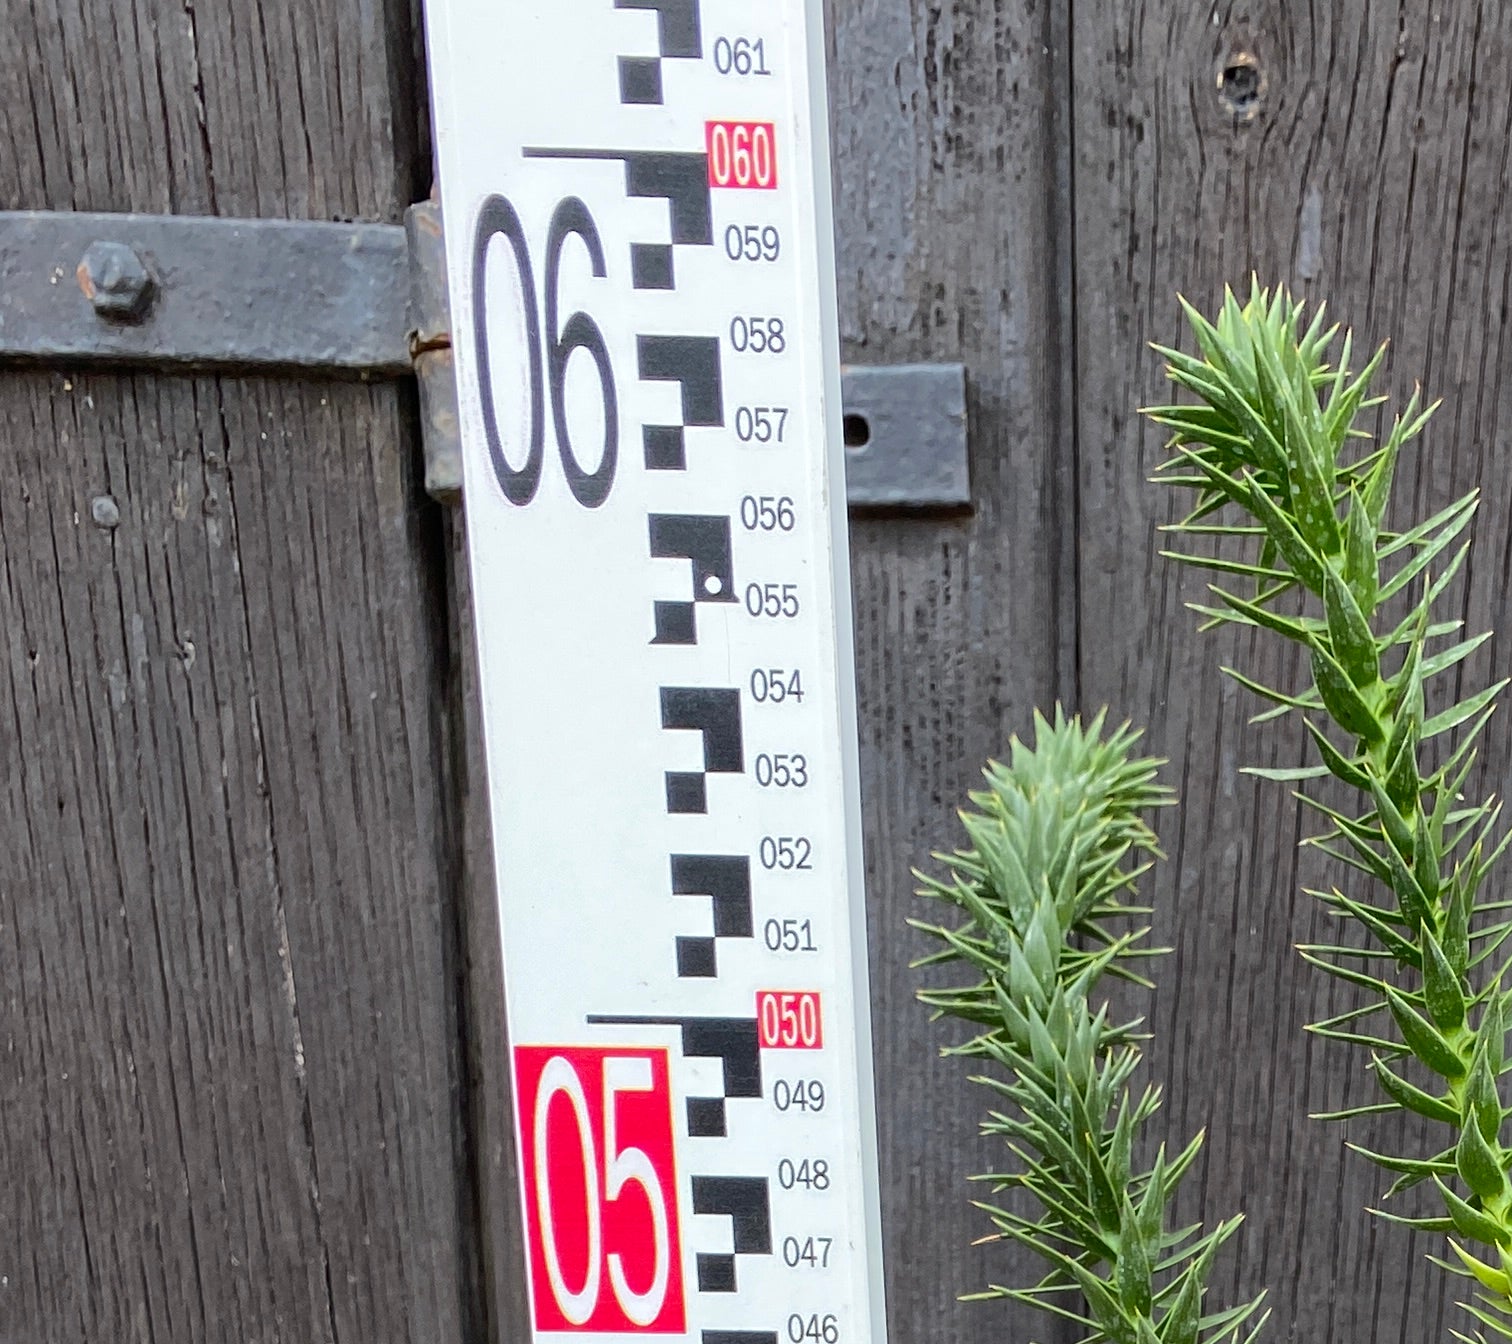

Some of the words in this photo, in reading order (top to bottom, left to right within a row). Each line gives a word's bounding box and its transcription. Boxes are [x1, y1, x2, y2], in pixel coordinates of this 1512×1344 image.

[714, 36, 771, 76] 061
[711, 123, 771, 187] 060
[724, 224, 780, 262] 059
[472, 193, 618, 508] 06
[730, 316, 786, 354] 058
[735, 406, 788, 443] 057
[740, 495, 795, 532] 056
[745, 582, 799, 618] 055
[750, 668, 805, 704] 054
[755, 753, 808, 788] 053
[759, 836, 813, 870] 052
[764, 918, 818, 952] 051
[762, 993, 817, 1047] 050
[773, 1079, 825, 1112] 049
[533, 1056, 670, 1326] 05
[778, 1158, 830, 1191] 048
[783, 1236, 833, 1268] 047
[787, 1313, 839, 1344] 046
